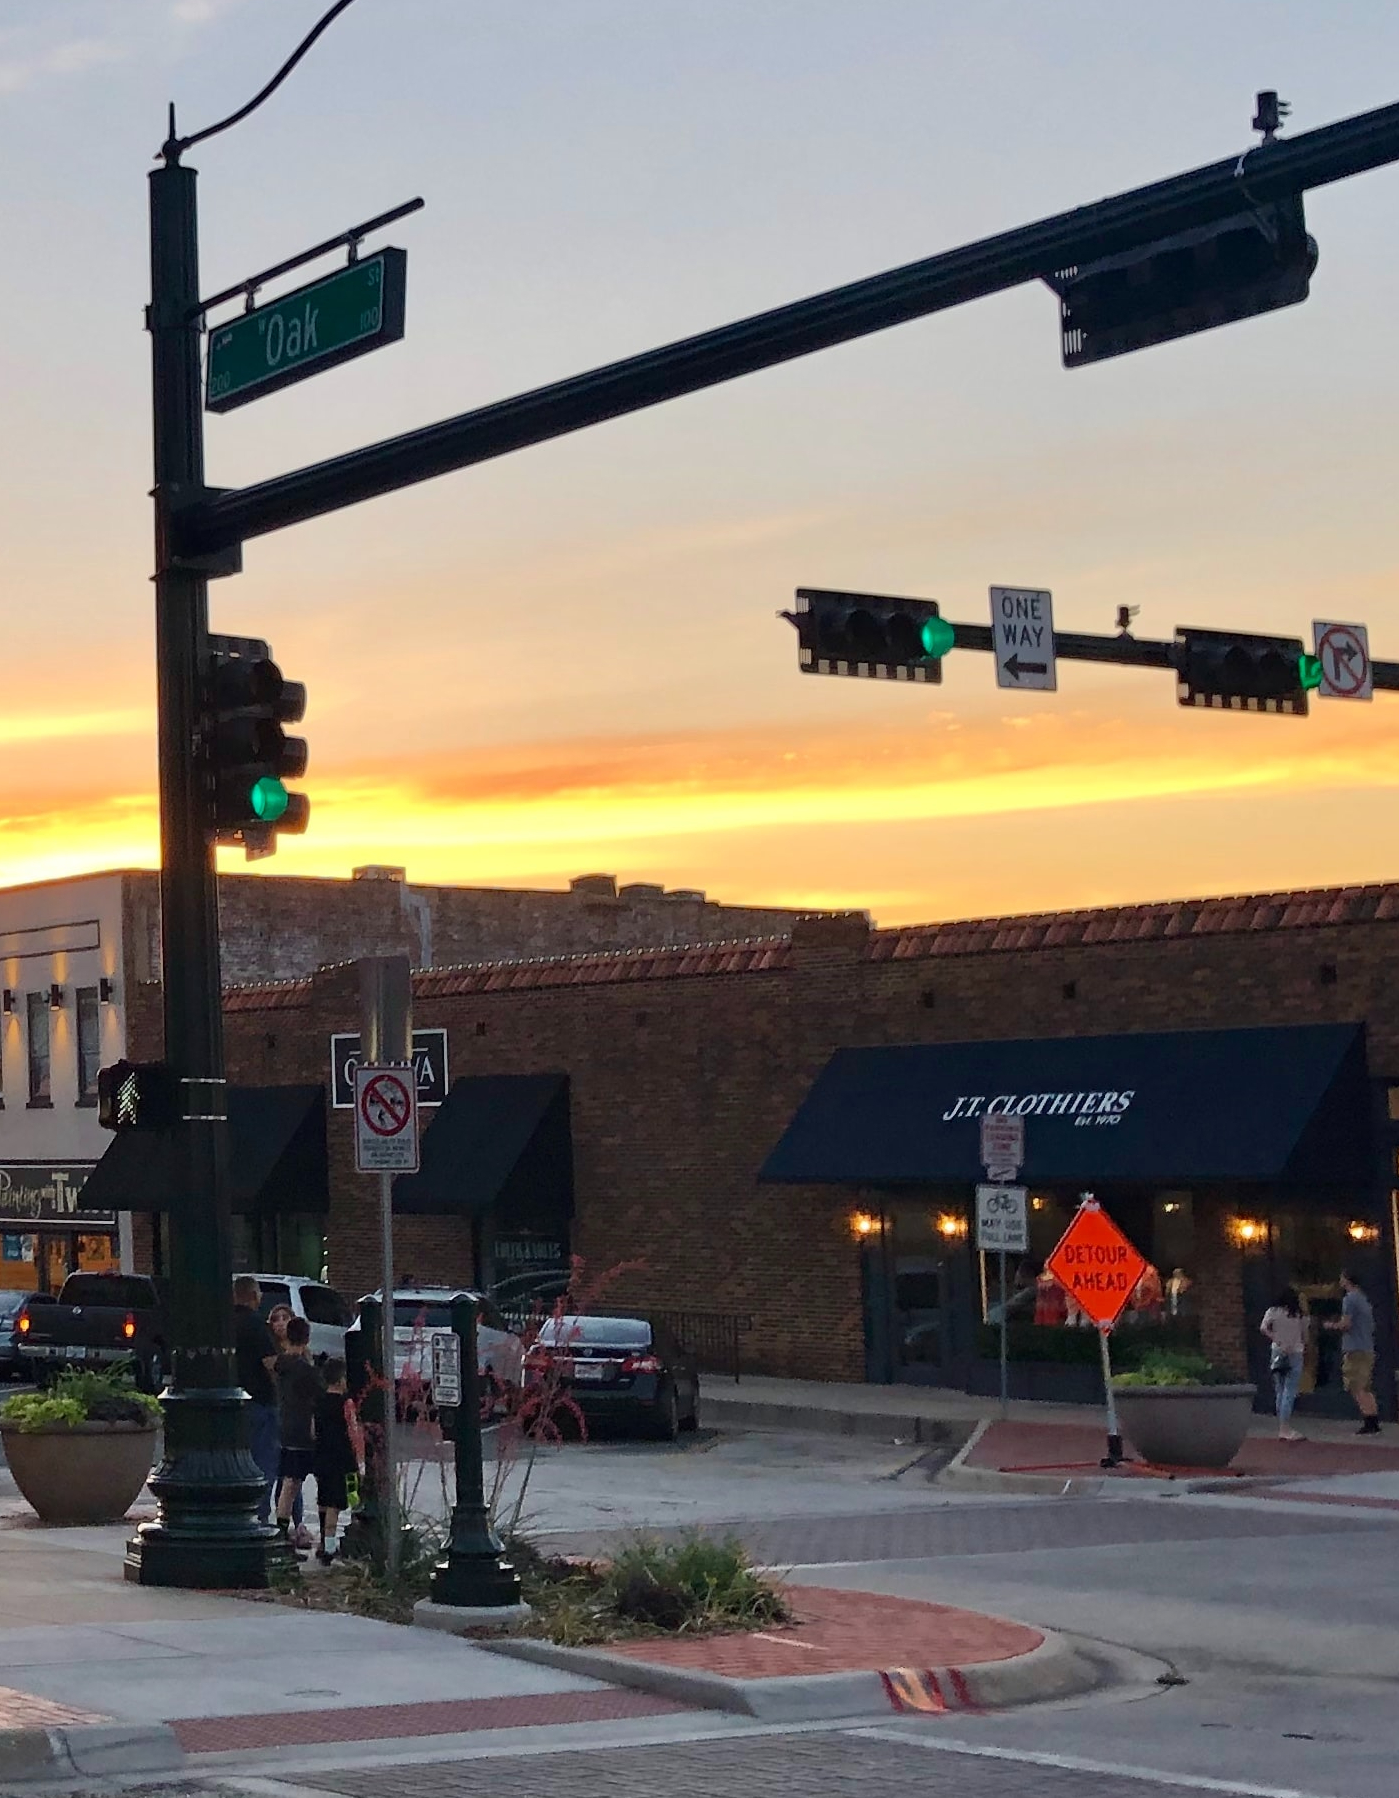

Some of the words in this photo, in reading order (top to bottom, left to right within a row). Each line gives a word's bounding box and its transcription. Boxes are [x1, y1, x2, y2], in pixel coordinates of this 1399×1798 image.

[266, 302, 319, 366] Oak
[1001, 596, 1042, 620] ONE
[1002, 623, 1044, 648] WAY
[943, 1096, 986, 1121] J.T.
[987, 1090, 1136, 1116] CLOTHIERS
[1064, 1244, 1128, 1265] DETOUR
[1072, 1271, 1128, 1292] AHEAD
